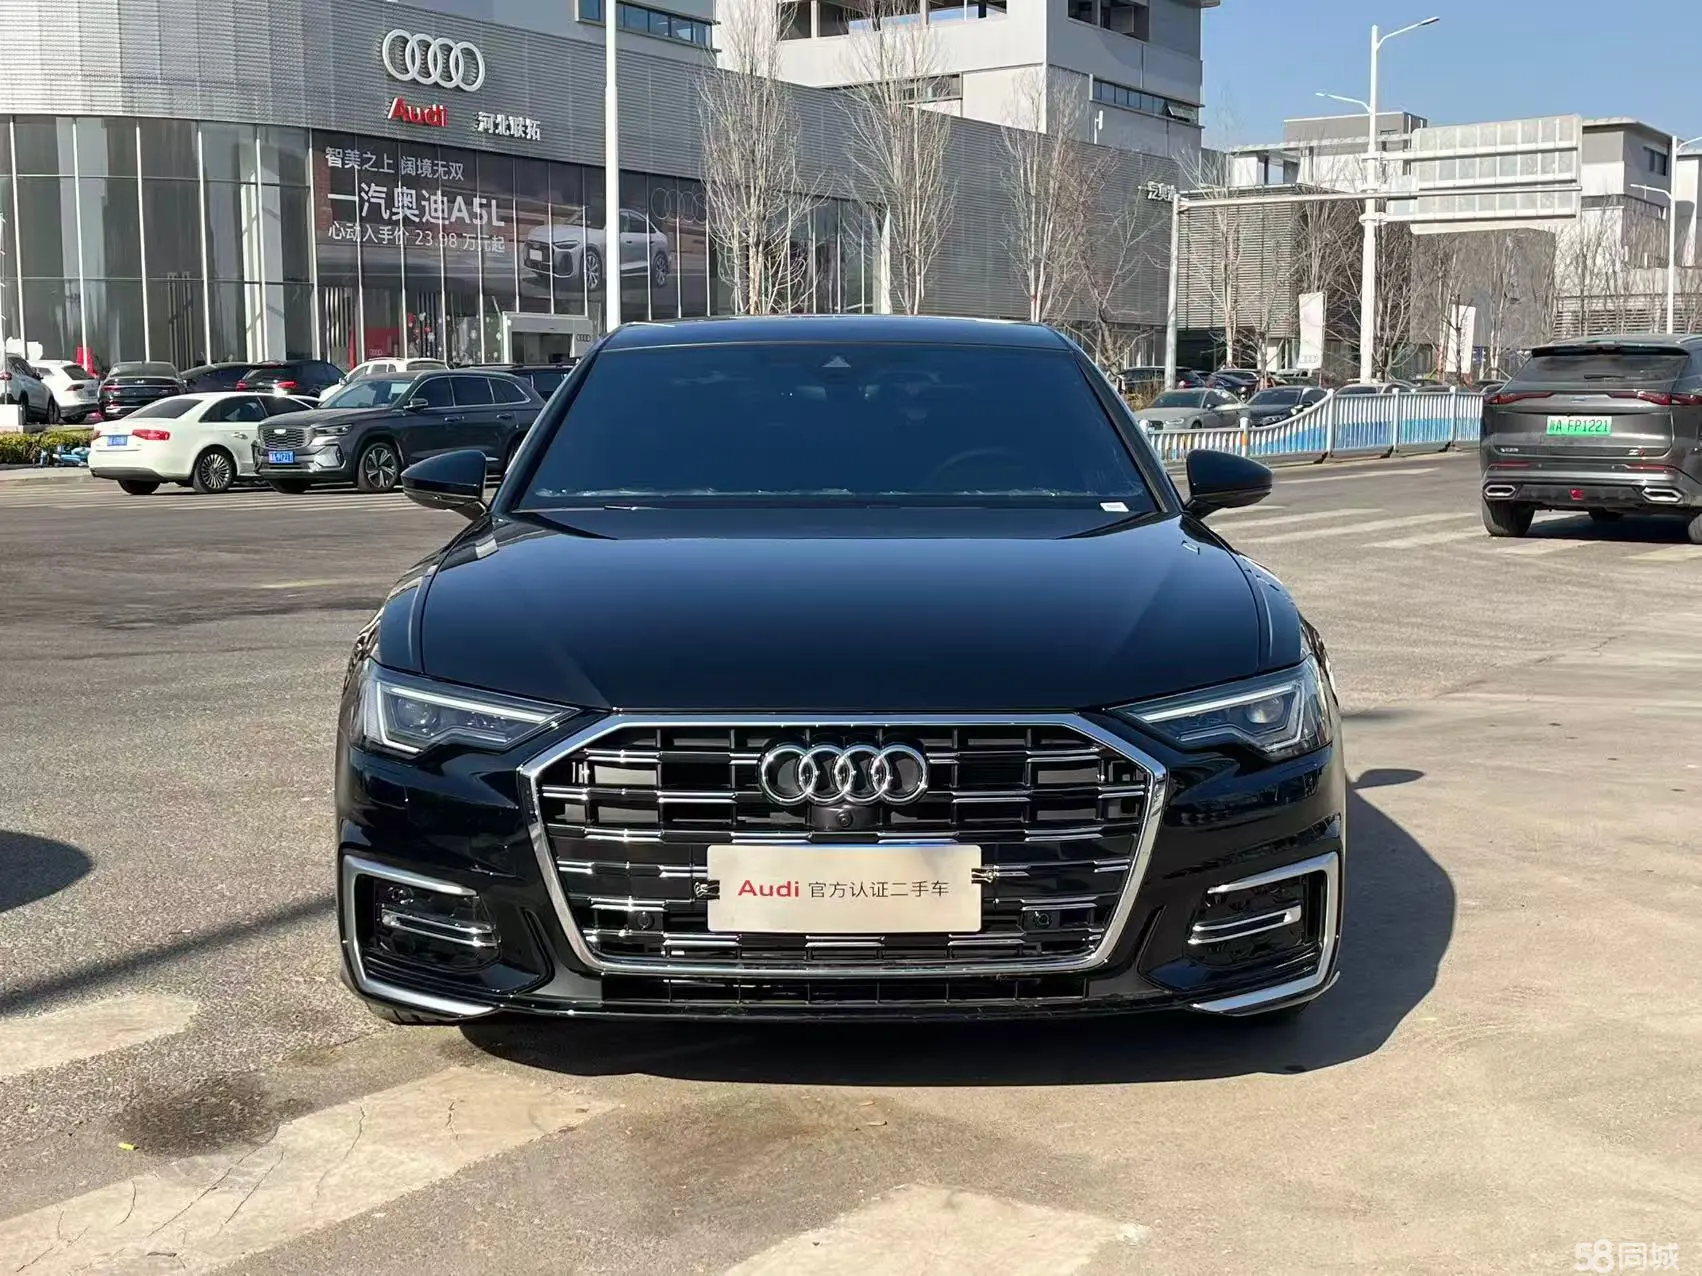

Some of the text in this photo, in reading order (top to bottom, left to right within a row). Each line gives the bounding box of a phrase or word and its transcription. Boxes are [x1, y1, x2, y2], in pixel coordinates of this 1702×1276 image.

[387, 96, 448, 127] Audi
[477, 111, 541, 141] 河北联拓
[325, 146, 464, 181] 智美之上 阔境无双
[327, 182, 506, 228] 一汽奥迪A5L
[328, 220, 410, 246] 心动入手价
[463, 232, 506, 254] 万元起
[738, 879, 950, 899] Audi 官方认证二手车
